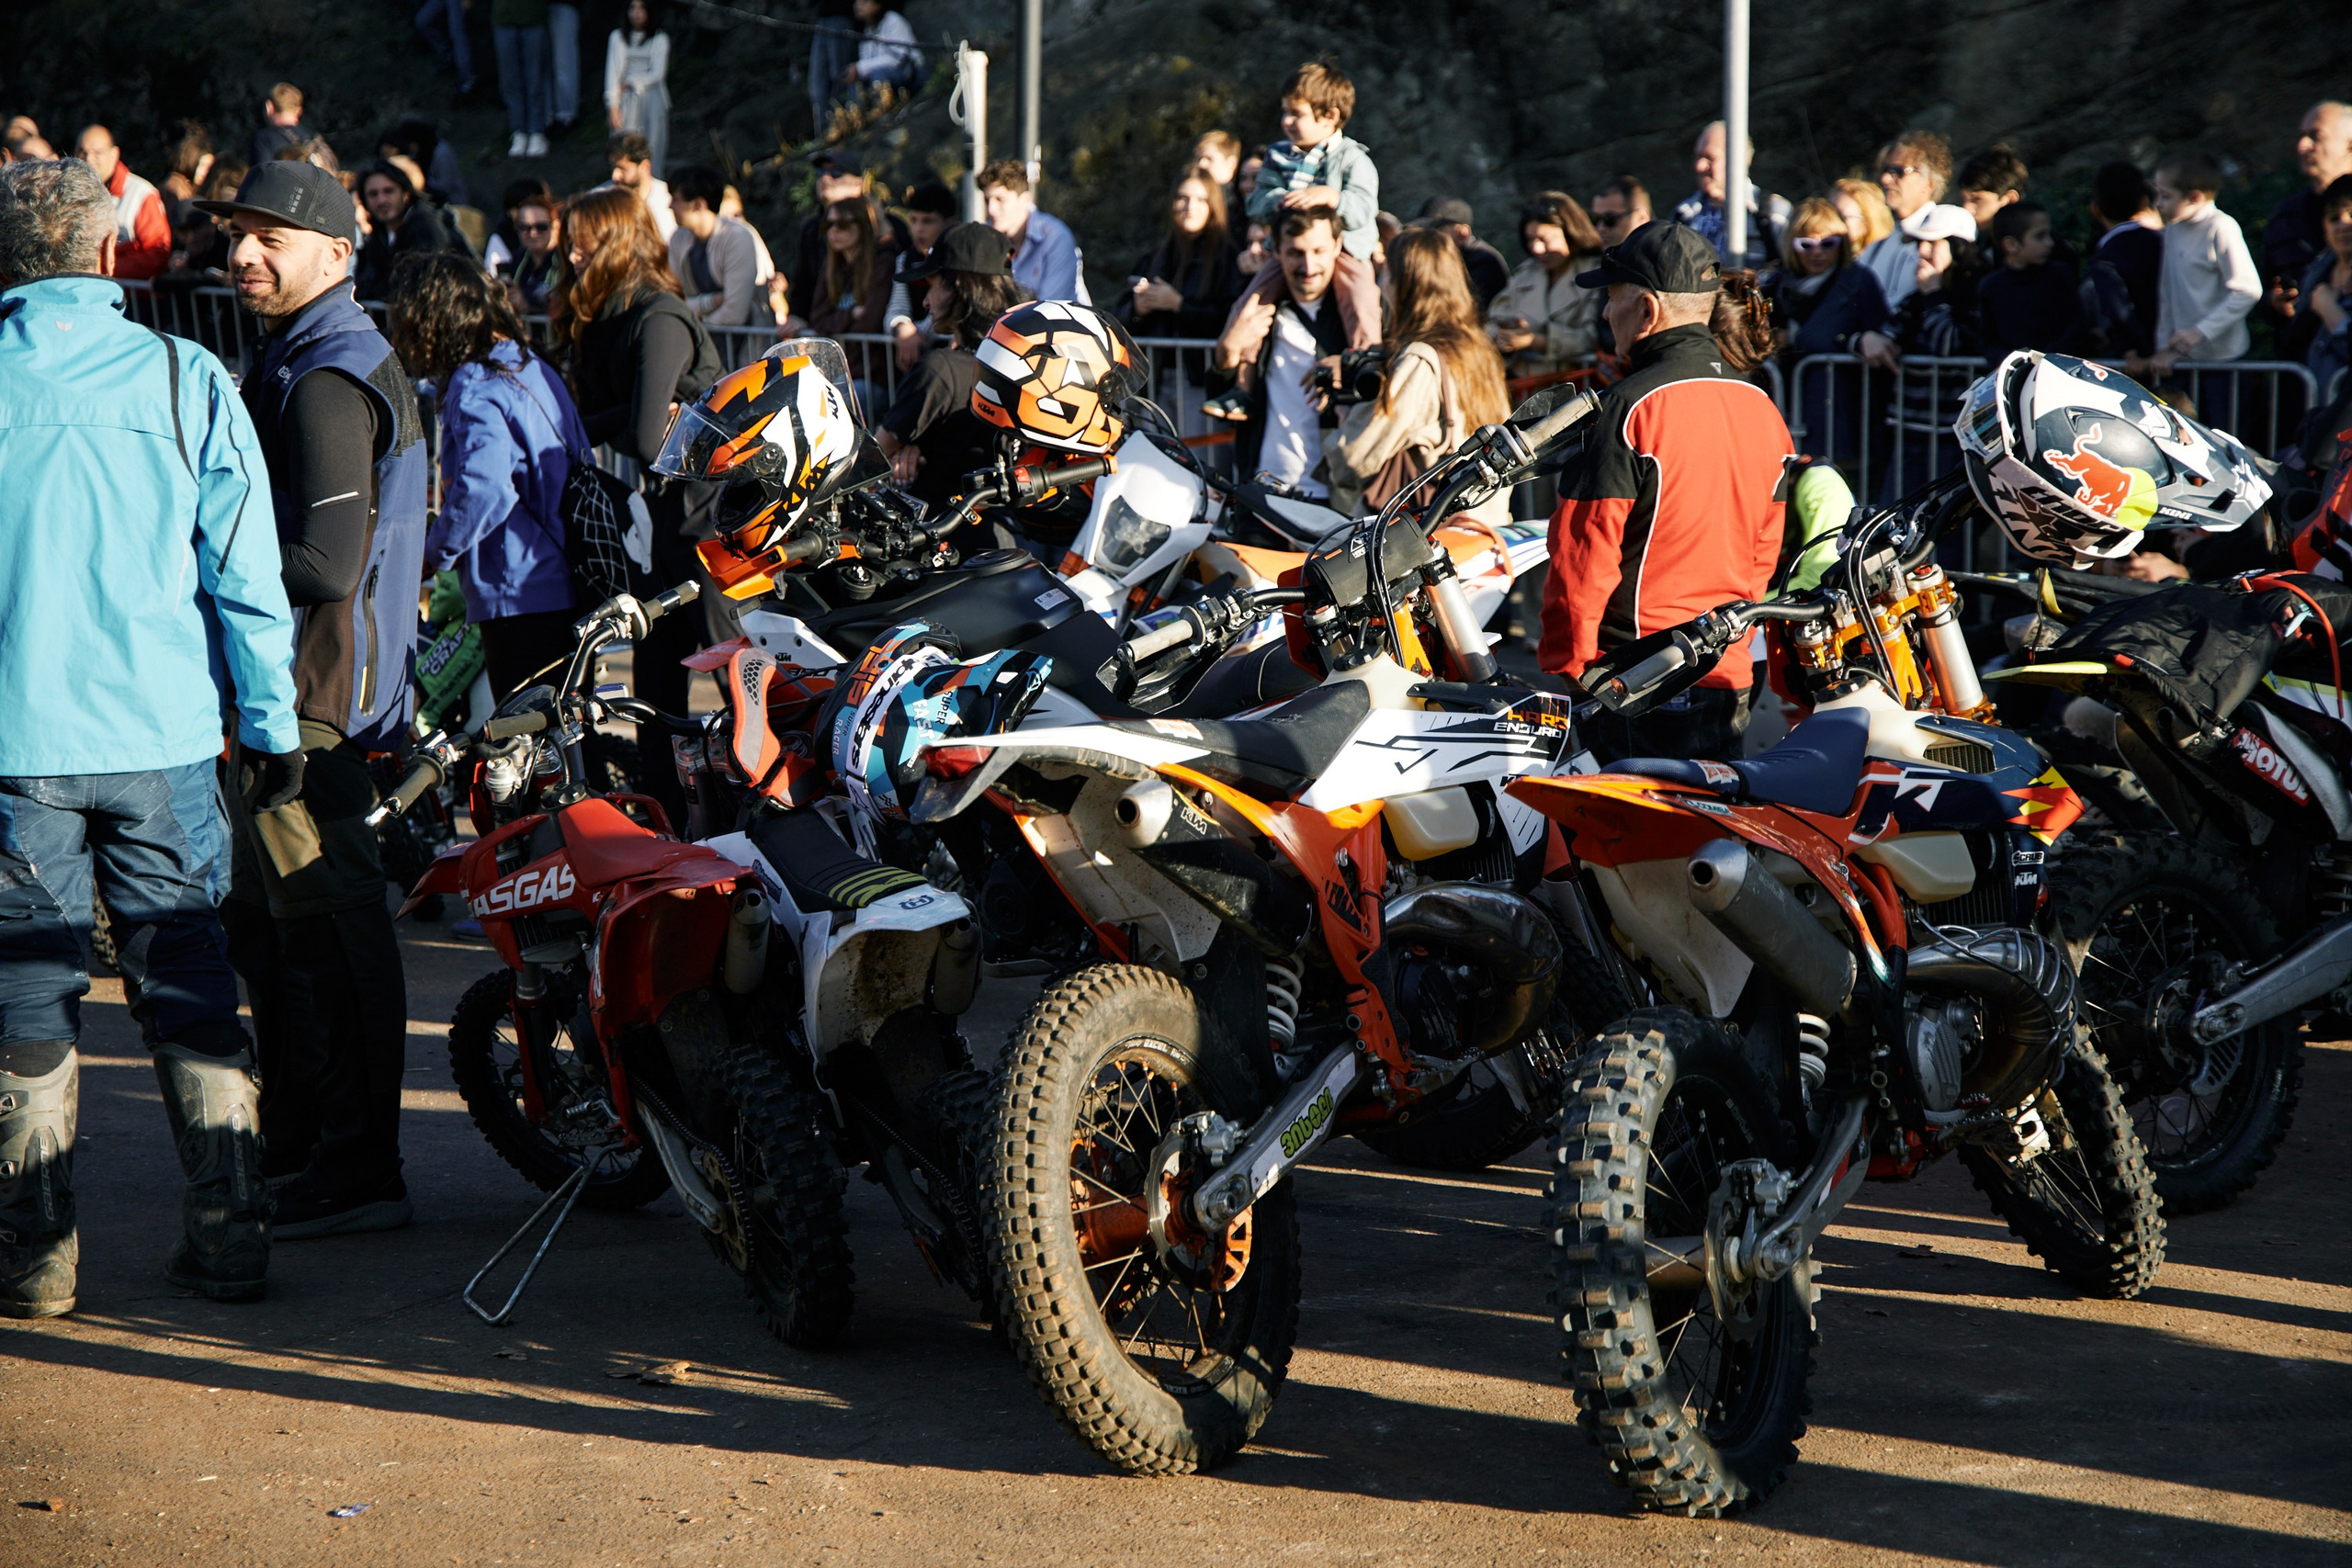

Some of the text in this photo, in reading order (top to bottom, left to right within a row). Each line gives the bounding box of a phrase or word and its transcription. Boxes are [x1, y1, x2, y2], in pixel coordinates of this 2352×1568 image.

[825, 384, 840, 421] KTM
[978, 402, 996, 417] KTM
[2159, 506, 2194, 521] KINI
[420, 636, 451, 675] RIDE
[775, 652, 792, 662] KTM
[912, 698, 935, 745] FAST
[935, 690, 955, 726] SUPER
[1507, 708, 1568, 729] HARD
[843, 710, 856, 737] SUPER
[1493, 722, 1562, 739] ENDURO
[831, 718, 843, 757] RACER
[1181, 807, 1208, 835] KTM
[461, 863, 576, 918] ASGAS
[2015, 872, 2038, 886] KTM
